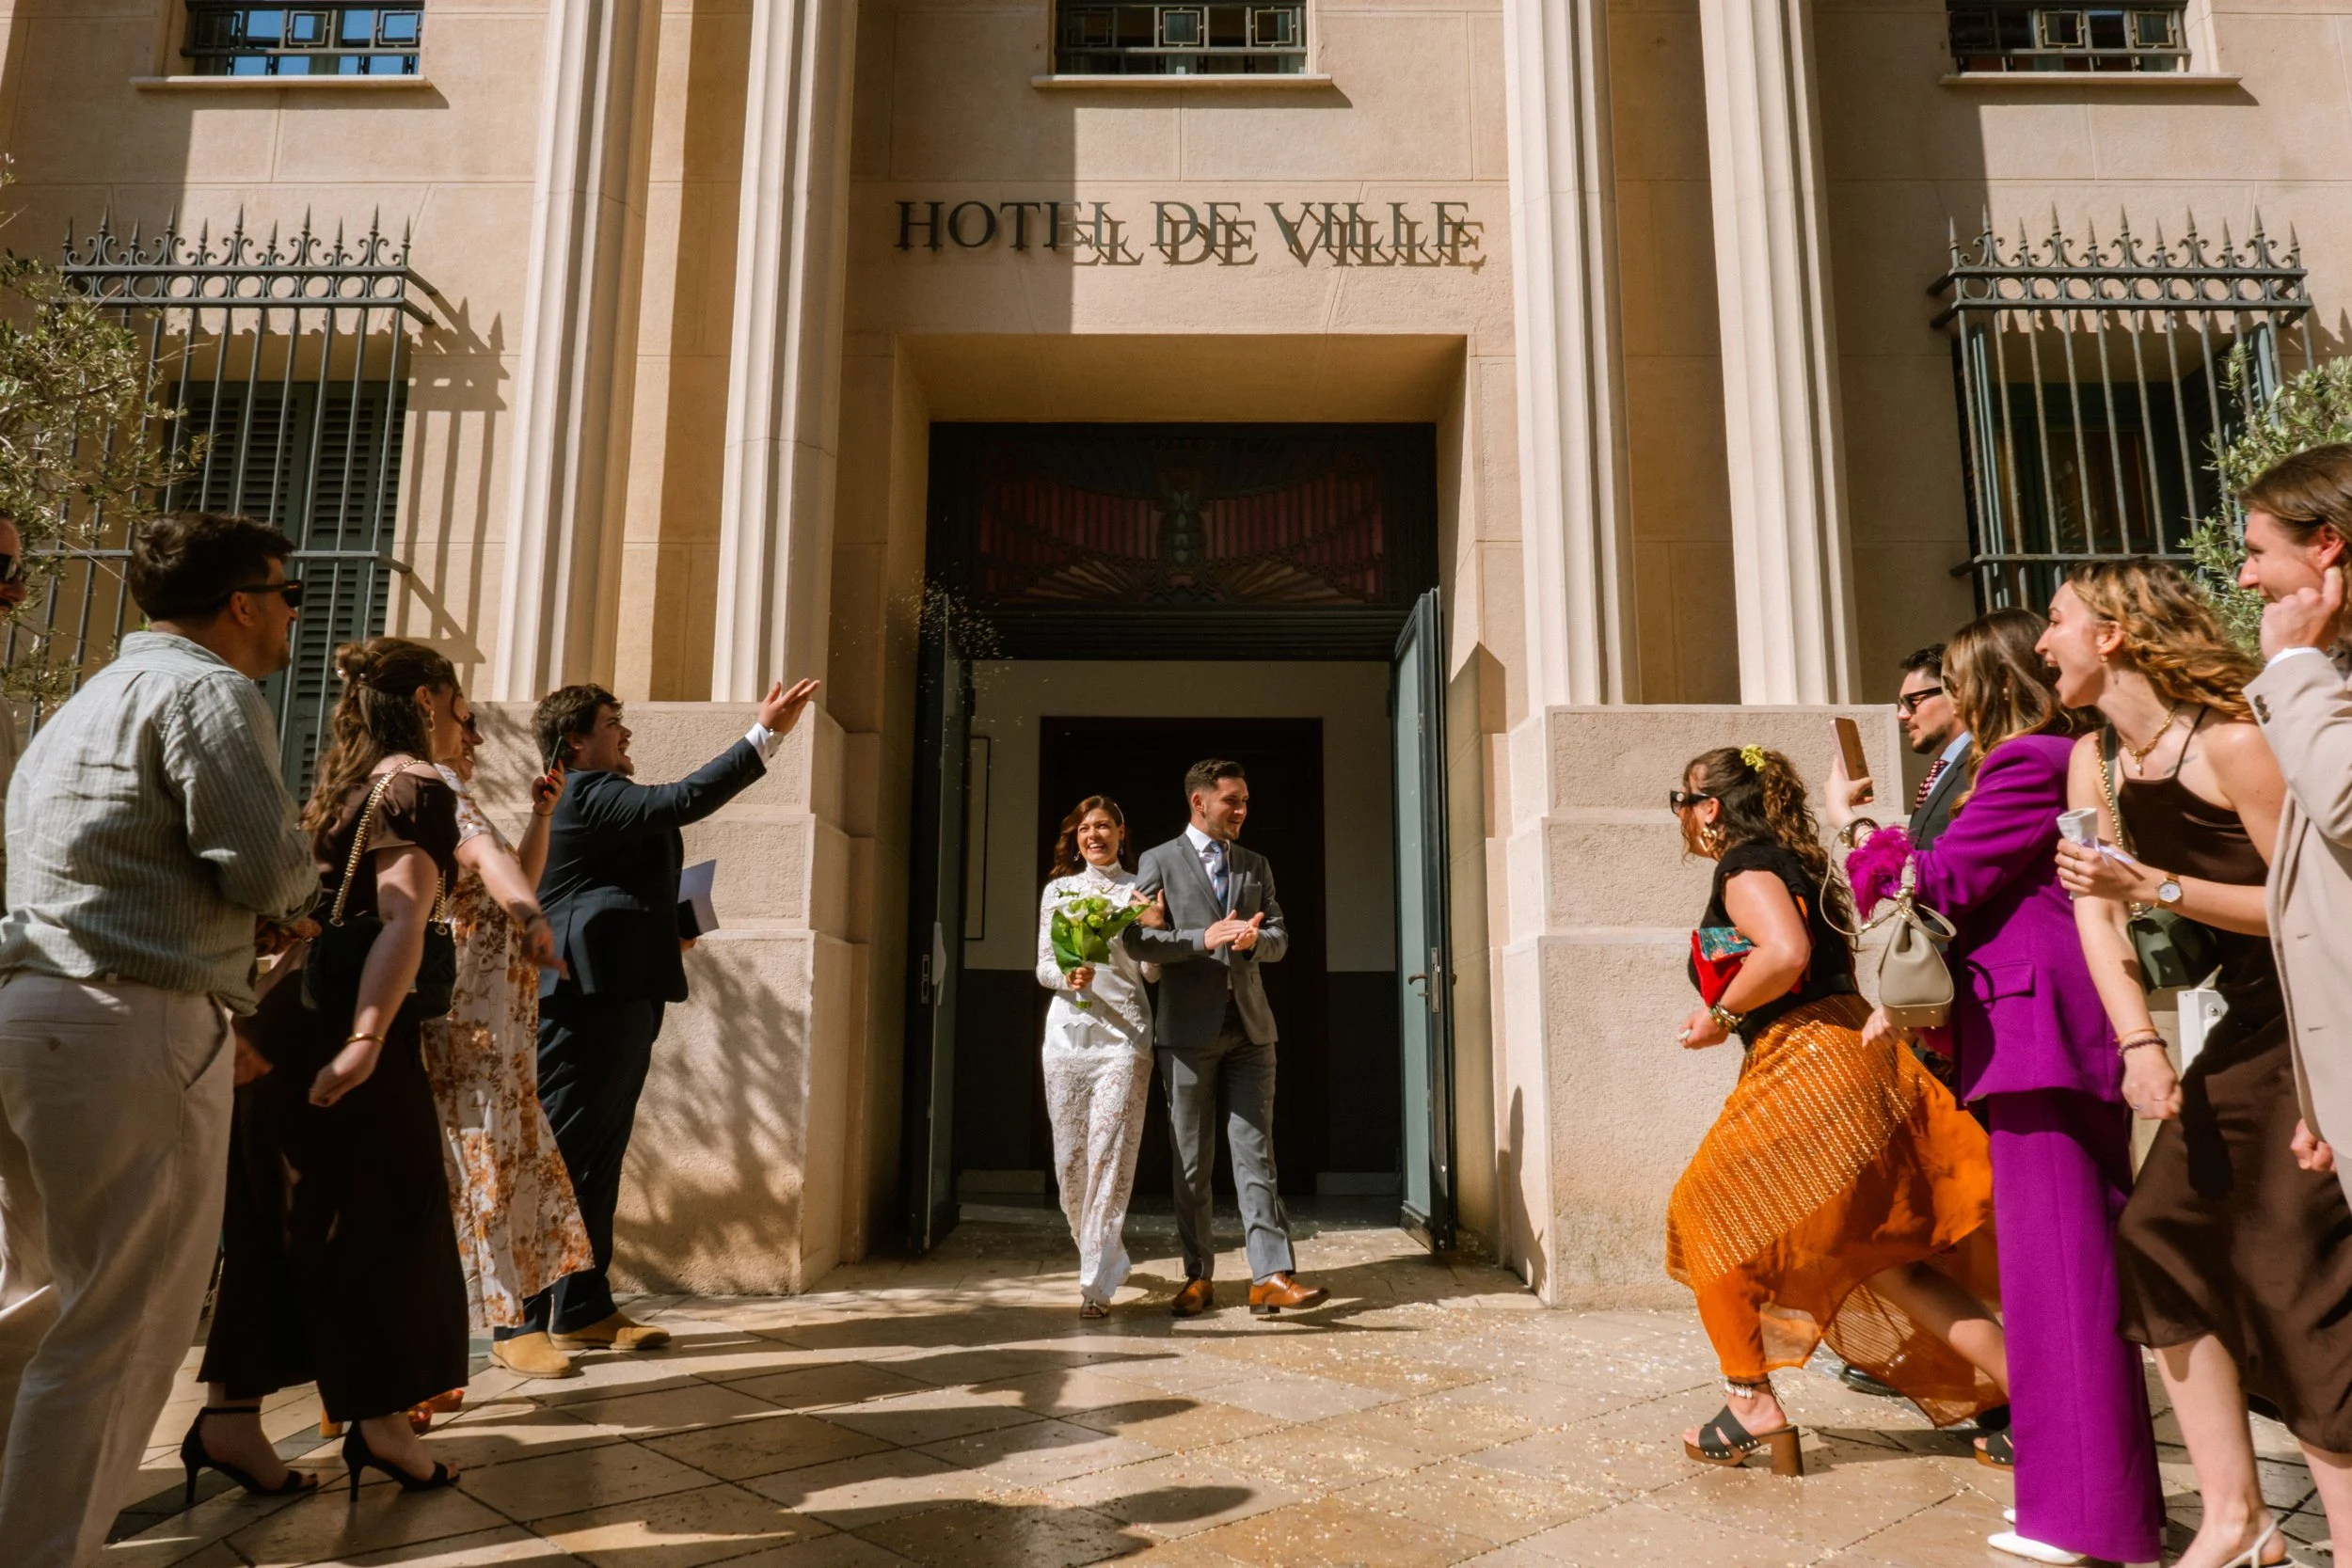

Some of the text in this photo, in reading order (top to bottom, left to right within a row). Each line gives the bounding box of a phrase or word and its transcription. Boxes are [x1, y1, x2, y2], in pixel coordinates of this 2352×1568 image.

[893, 200, 1473, 249] HOTEL DE VILLE
